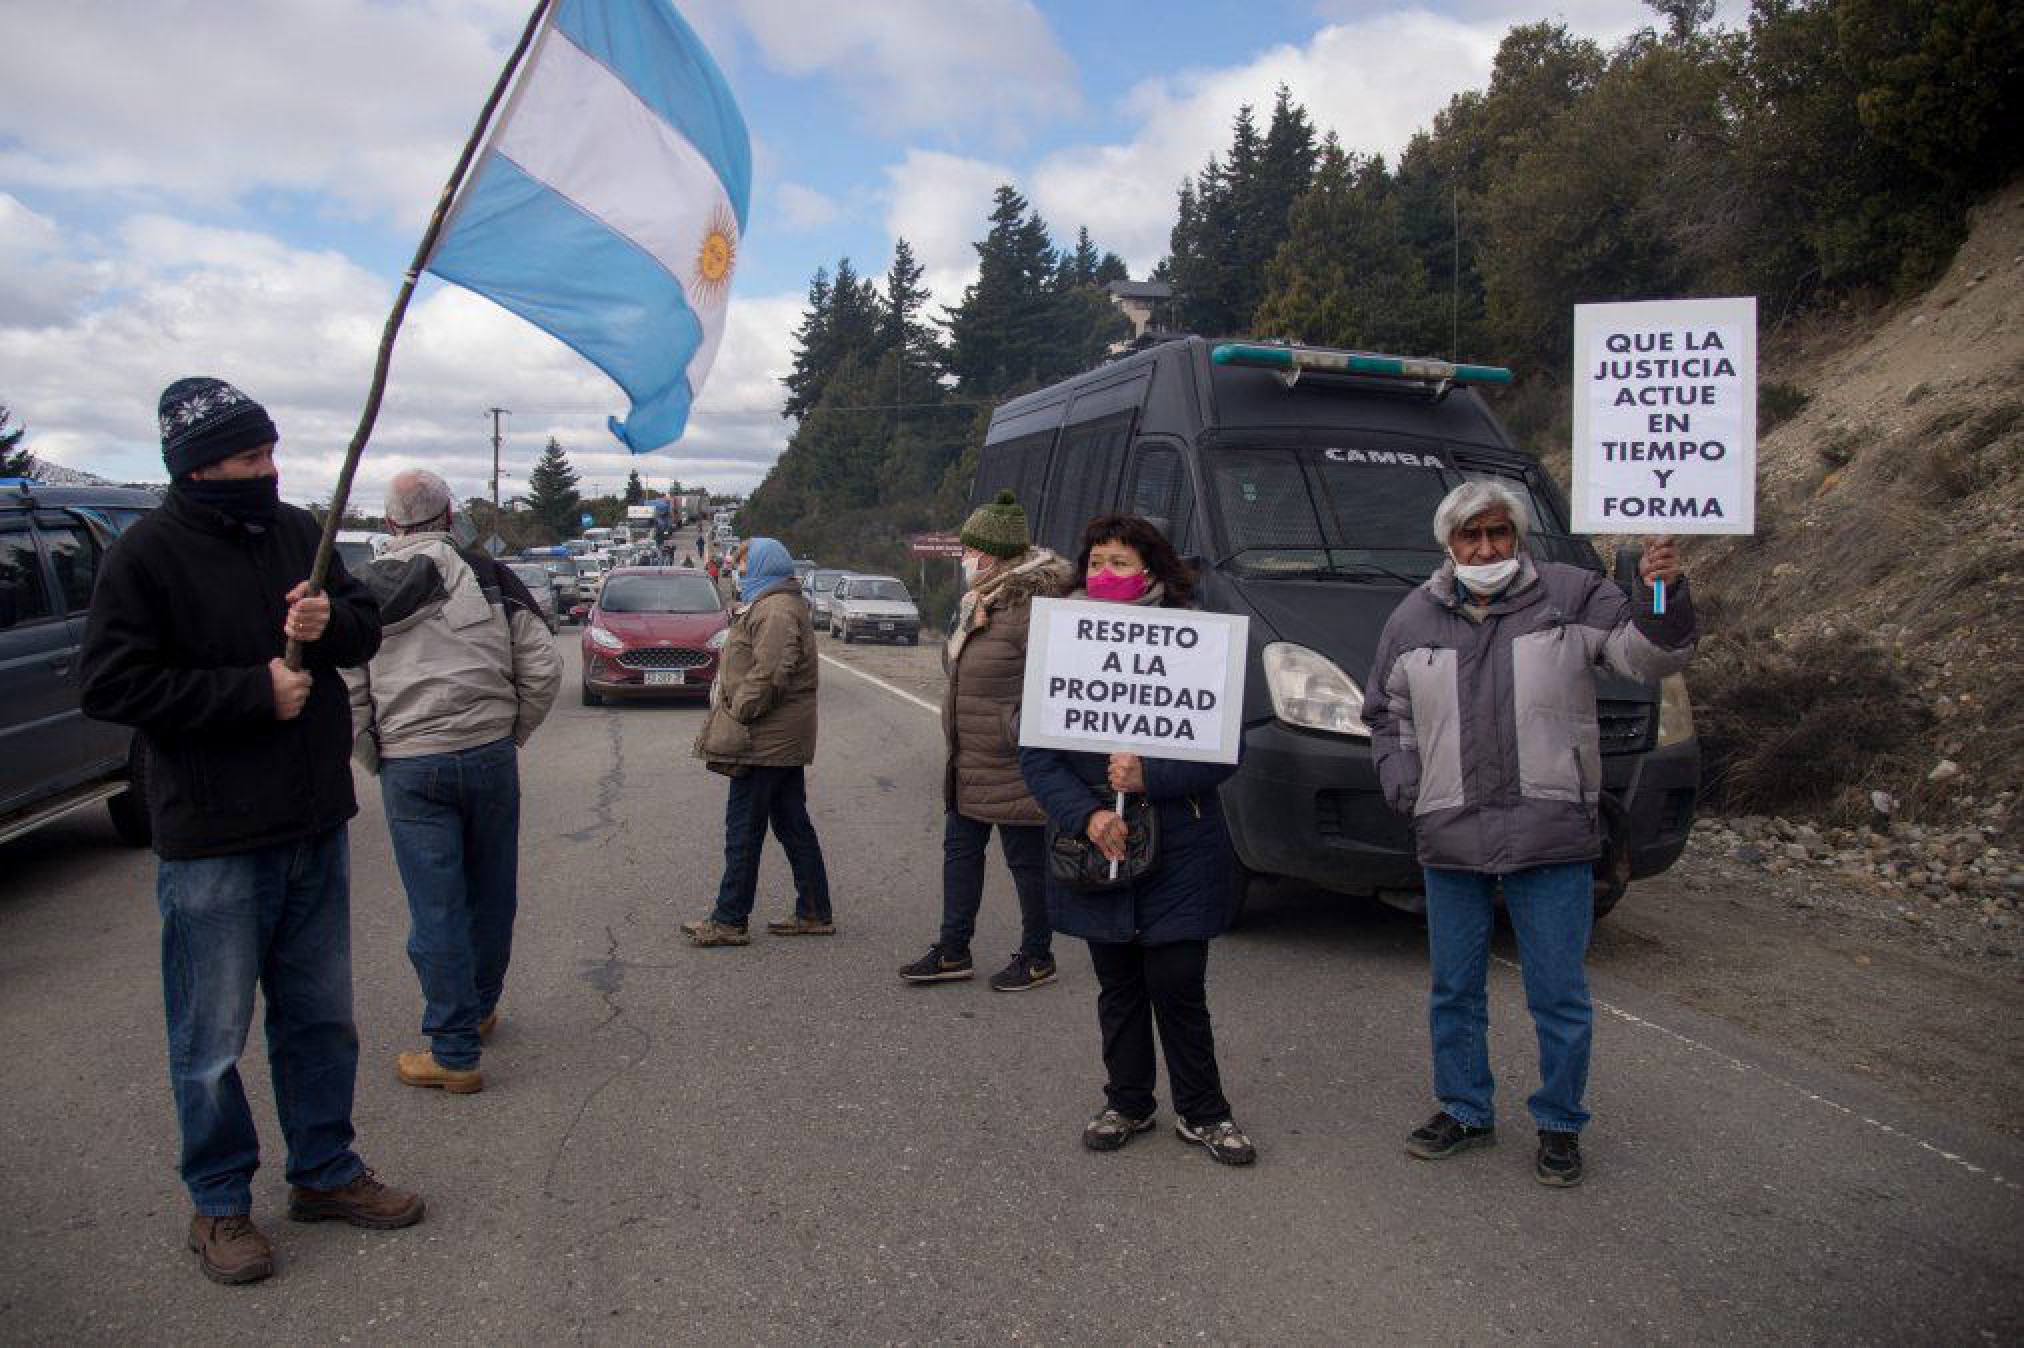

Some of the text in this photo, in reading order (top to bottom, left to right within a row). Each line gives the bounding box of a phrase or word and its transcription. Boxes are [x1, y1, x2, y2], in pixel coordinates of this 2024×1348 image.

[1605, 331, 1725, 353] QUE LA
[1593, 357, 1737, 381] JUSTICIA
[1613, 385, 1716, 407] ACTUE
[1648, 413, 1691, 433] EN
[1324, 448, 1445, 469] CAMBA
[1601, 440, 1727, 462] TIEMPO
[1652, 469, 1675, 489] Y
[1602, 496, 1725, 518] FORMA
[1076, 618, 1200, 649] RESPETO
[1101, 651, 1167, 677] A LA
[1049, 677, 1217, 711] PROPIEDAD
[1064, 707, 1195, 741] PRIVADA
